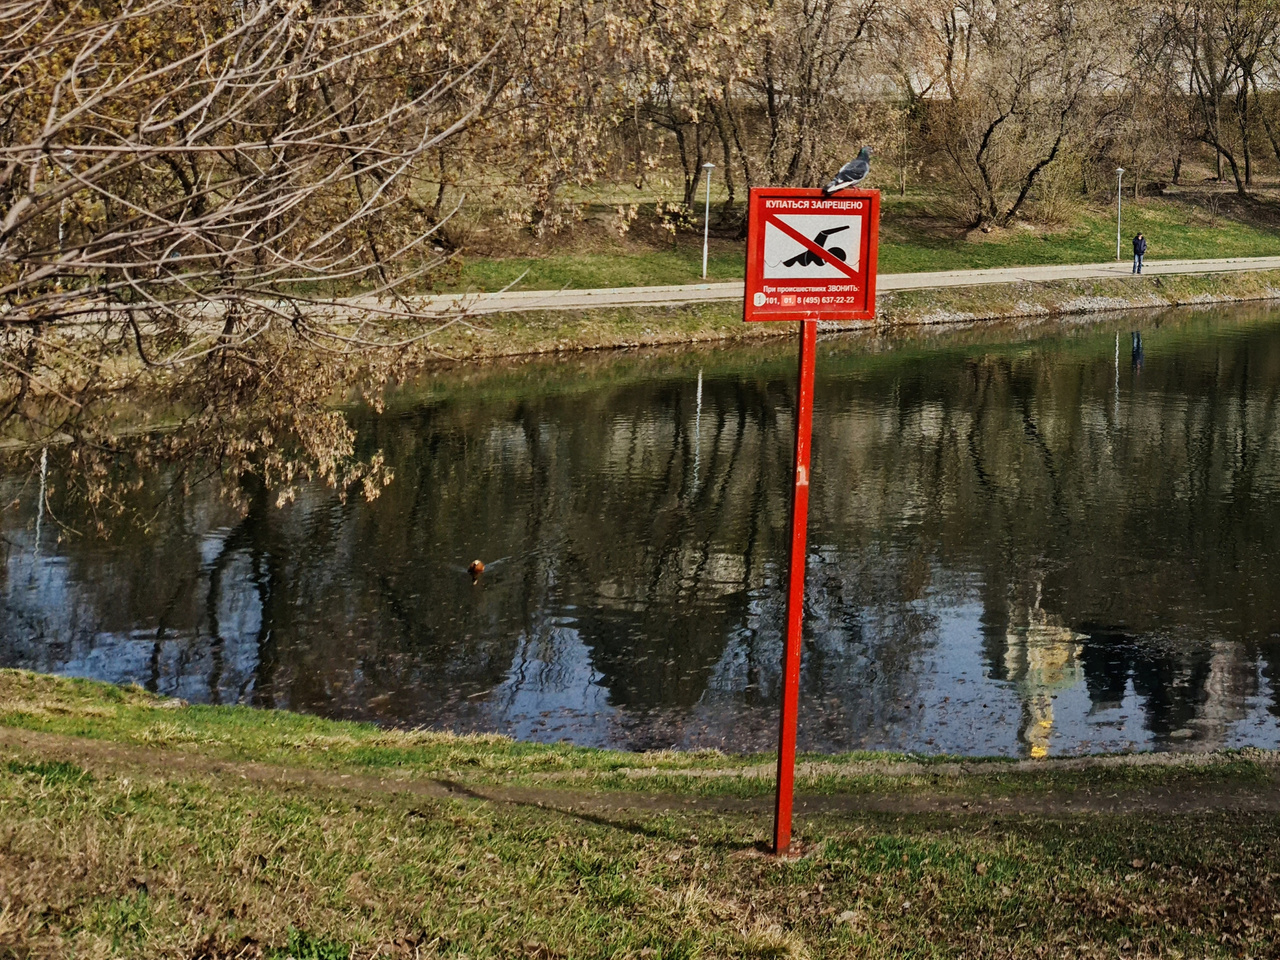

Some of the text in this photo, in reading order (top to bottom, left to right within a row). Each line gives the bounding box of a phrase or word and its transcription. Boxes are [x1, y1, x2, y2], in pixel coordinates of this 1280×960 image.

[766, 200, 863, 210] КУПАТЬСЯ ЗАПРЕЩЕНО
[803, 296, 820, 305] (495)
